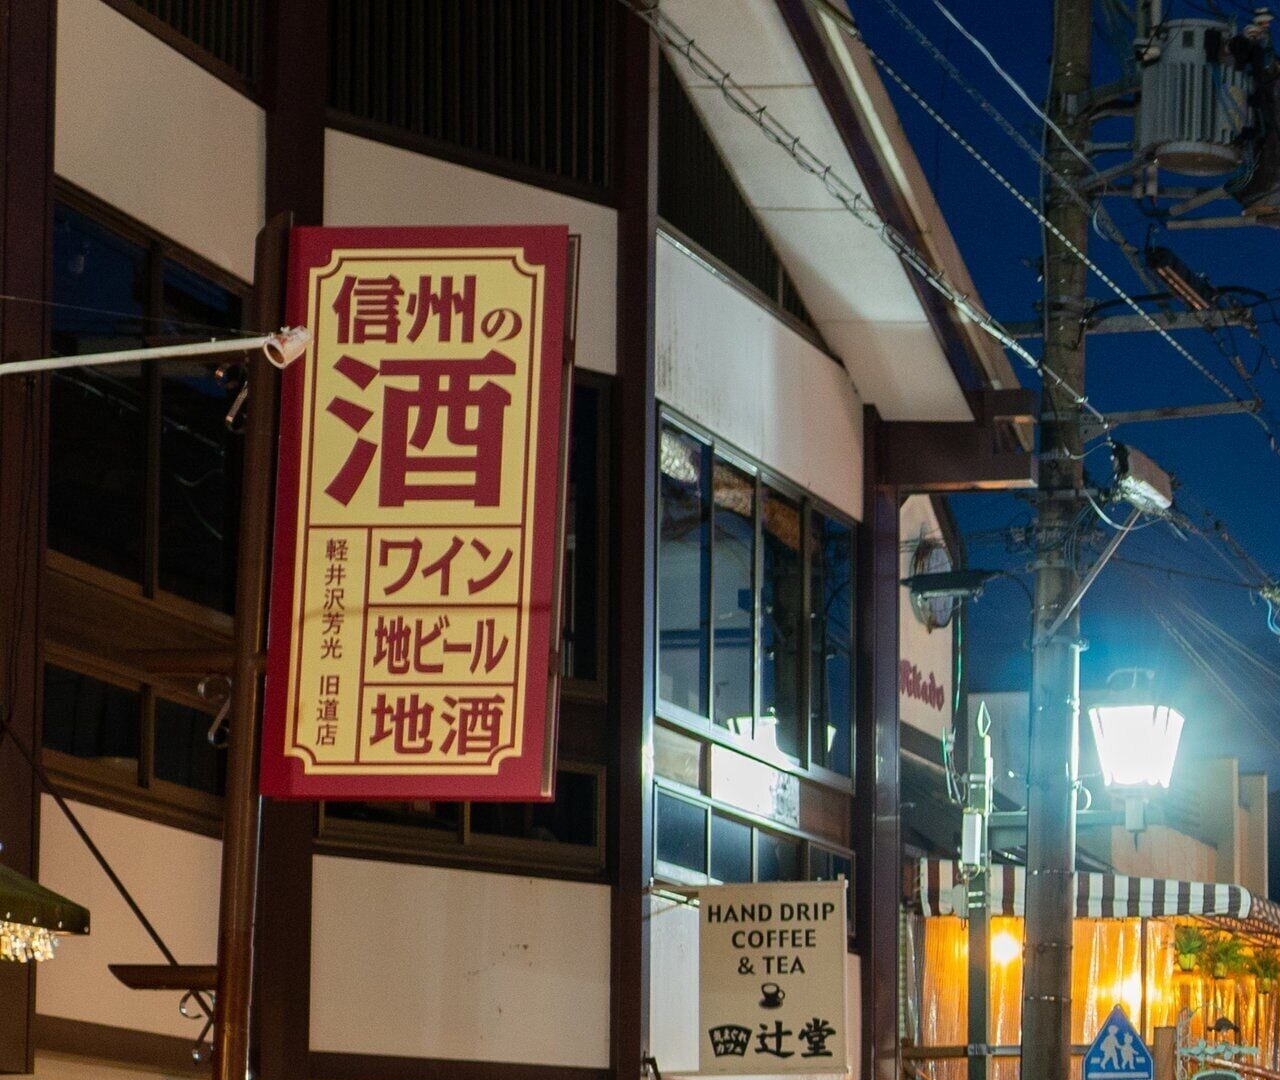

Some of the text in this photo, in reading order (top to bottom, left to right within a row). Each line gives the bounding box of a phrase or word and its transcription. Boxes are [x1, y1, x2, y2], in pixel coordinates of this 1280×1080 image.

[332, 274, 524, 346] 信州の
[323, 349, 517, 509] 酒
[376, 534, 515, 597] ワイン
[314, 538, 350, 748] 軽井沢芳光 旧道店
[372, 614, 510, 677] 地ビール
[368, 692, 506, 758] 地酒
[707, 902, 836, 924] HAND DRIP
[731, 928, 817, 950] COFFEE
[736, 955, 806, 976] & TEA
[754, 1016, 837, 1059] 辻堂
